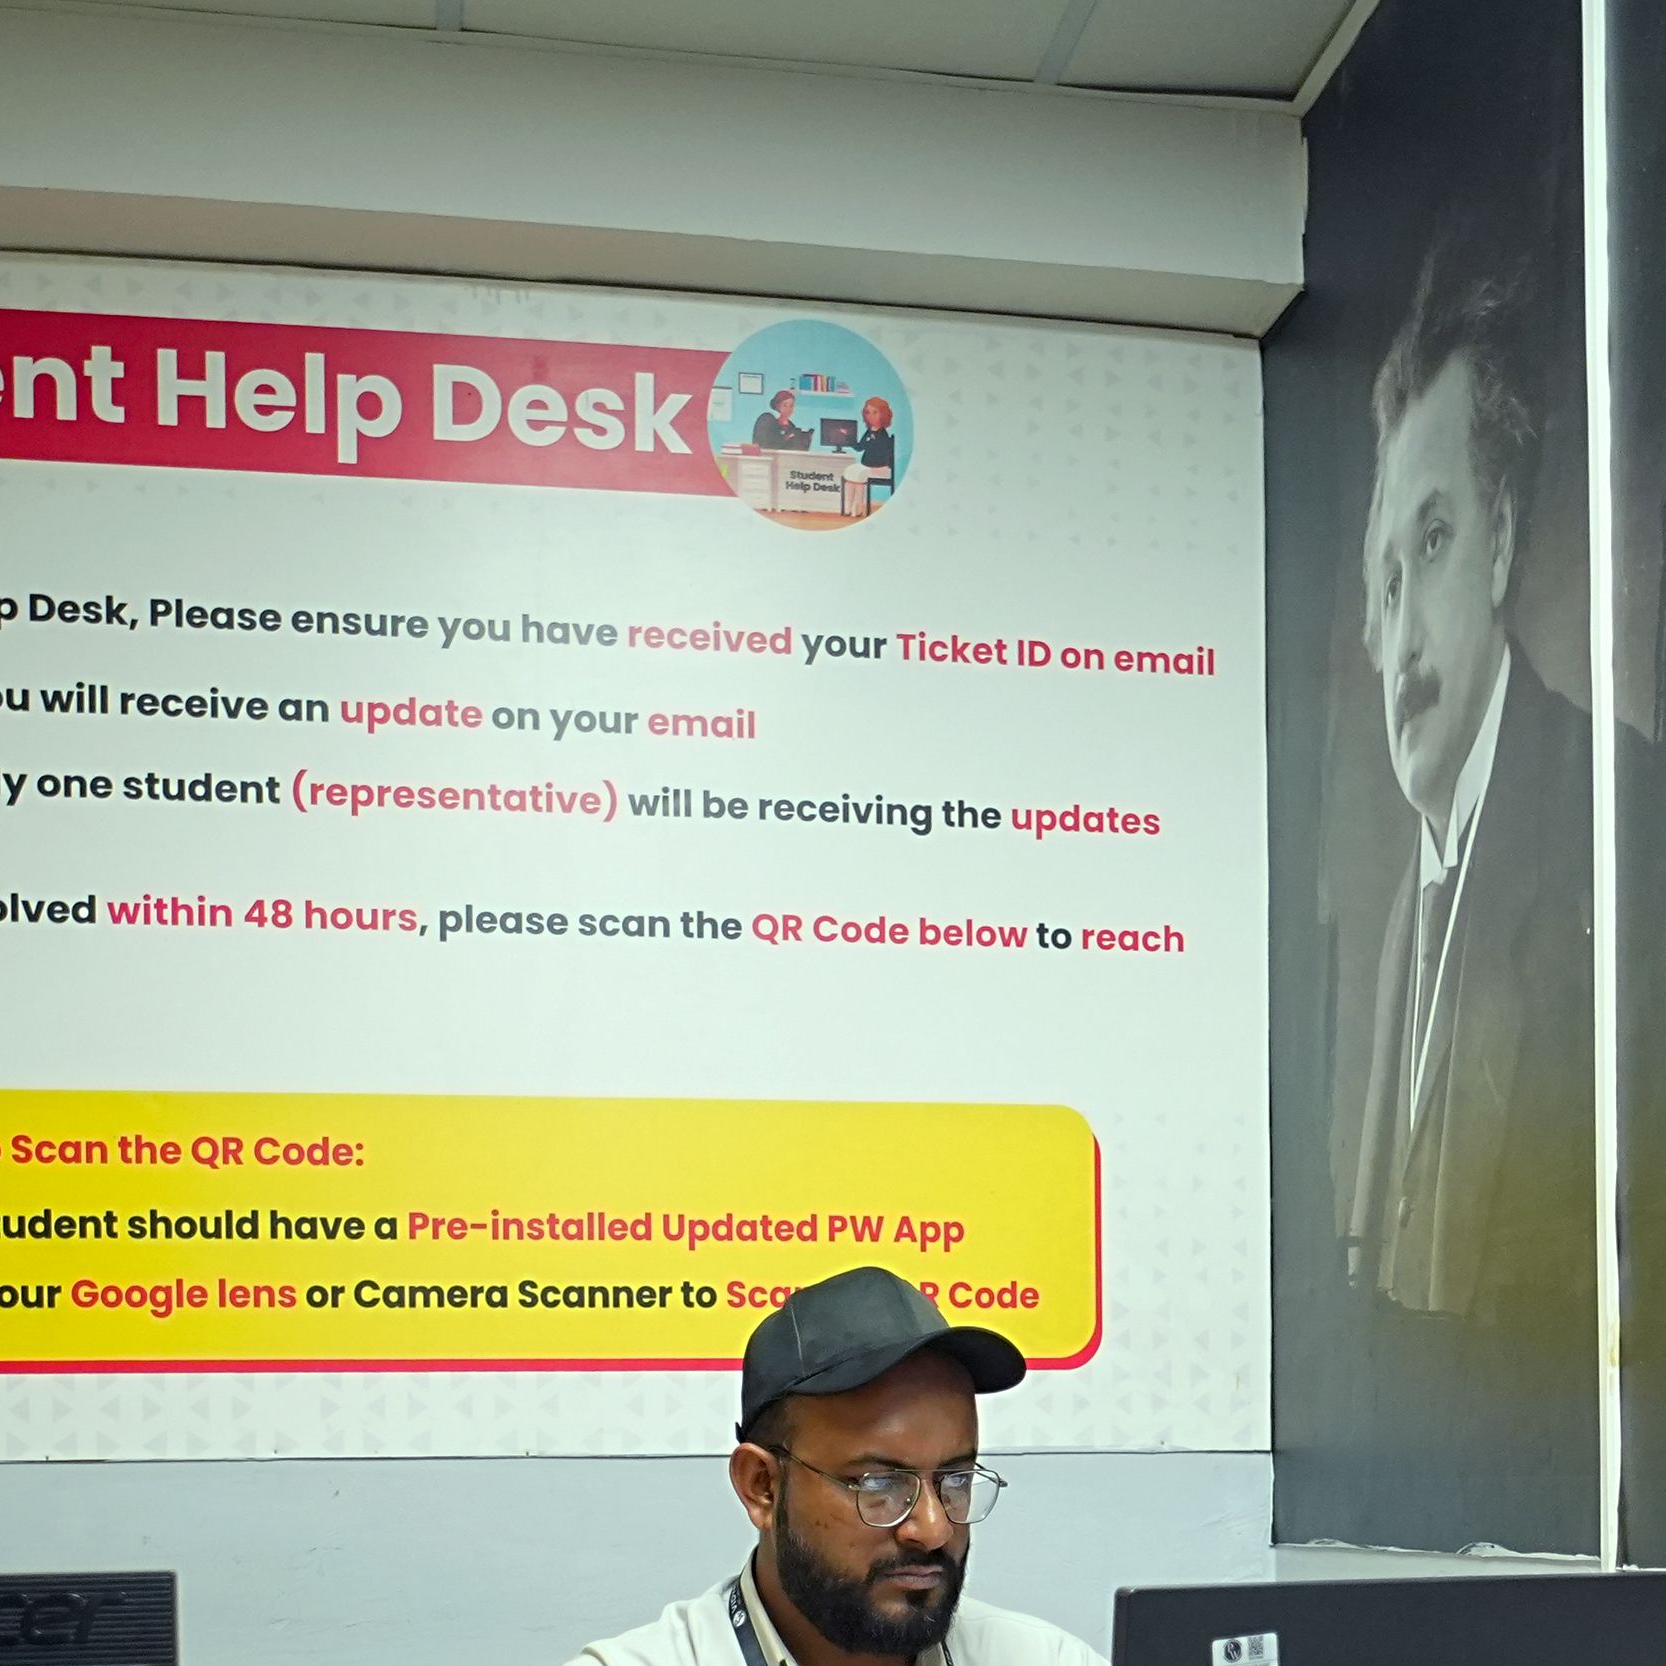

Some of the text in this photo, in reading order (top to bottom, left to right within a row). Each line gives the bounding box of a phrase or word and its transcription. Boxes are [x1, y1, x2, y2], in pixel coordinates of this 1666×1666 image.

[156, 348, 403, 465] Help
[433, 363, 693, 455] Desk
[786, 481, 841, 493] Help Desk
[789, 470, 833, 482] Student
[29, 594, 138, 630] Desk,
[150, 599, 282, 631] Please
[291, 611, 428, 638] ensure
[438, 617, 510, 648] you
[522, 614, 617, 645] have
[630, 622, 791, 654] received
[801, 634, 887, 665] your
[896, 631, 1007, 665] Ticket
[1018, 640, 1051, 667] ID
[1061, 647, 1104, 670] on
[1114, 646, 1214, 675] email
[40, 682, 108, 714] will
[121, 687, 268, 720] receive
[278, 699, 329, 722] an
[341, 697, 482, 734] update
[492, 708, 539, 730] on
[550, 710, 638, 740] your
[649, 709, 754, 738] email
[37, 774, 113, 798] one
[123, 773, 280, 804] student
[293, 769, 617, 822] (representative)
[628, 787, 691, 817] will
[703, 790, 748, 819] be
[759, 793, 932, 836] receiving
[942, 800, 1001, 829] the
[1012, 804, 1160, 840] updates
[107, 894, 232, 927] within
[244, 899, 293, 928] 48
[305, 900, 428, 936] hours,
[440, 905, 568, 942] please
[579, 914, 670, 937] scan
[680, 911, 742, 939] the
[752, 914, 802, 945] QR
[813, 916, 909, 944] Code
[920, 917, 1028, 948] below
[1036, 923, 1072, 949] to
[1082, 925, 1184, 952] reach
[11, 1135, 108, 1164] Scan
[118, 1135, 182, 1164] the
[191, 1136, 243, 1169] QR
[254, 1137, 364, 1166] Code:
[128, 1209, 259, 1239] should
[270, 1210, 365, 1240] have
[374, 1217, 397, 1240] a
[409, 1209, 652, 1241] Pre-installed
[663, 1213, 817, 1251] Updated
[829, 1215, 884, 1242] PW
[894, 1216, 965, 1252] App
[71, 1278, 208, 1318] Google
[219, 1278, 297, 1308] lens
[306, 1285, 345, 1308] or
[354, 1280, 508, 1308] Camera
[518, 1280, 672, 1308] Scanner
[681, 1281, 717, 1308] to
[726, 1280, 803, 1308] Sca
[919, 1281, 940, 1308] R
[949, 1280, 1040, 1309] Code
